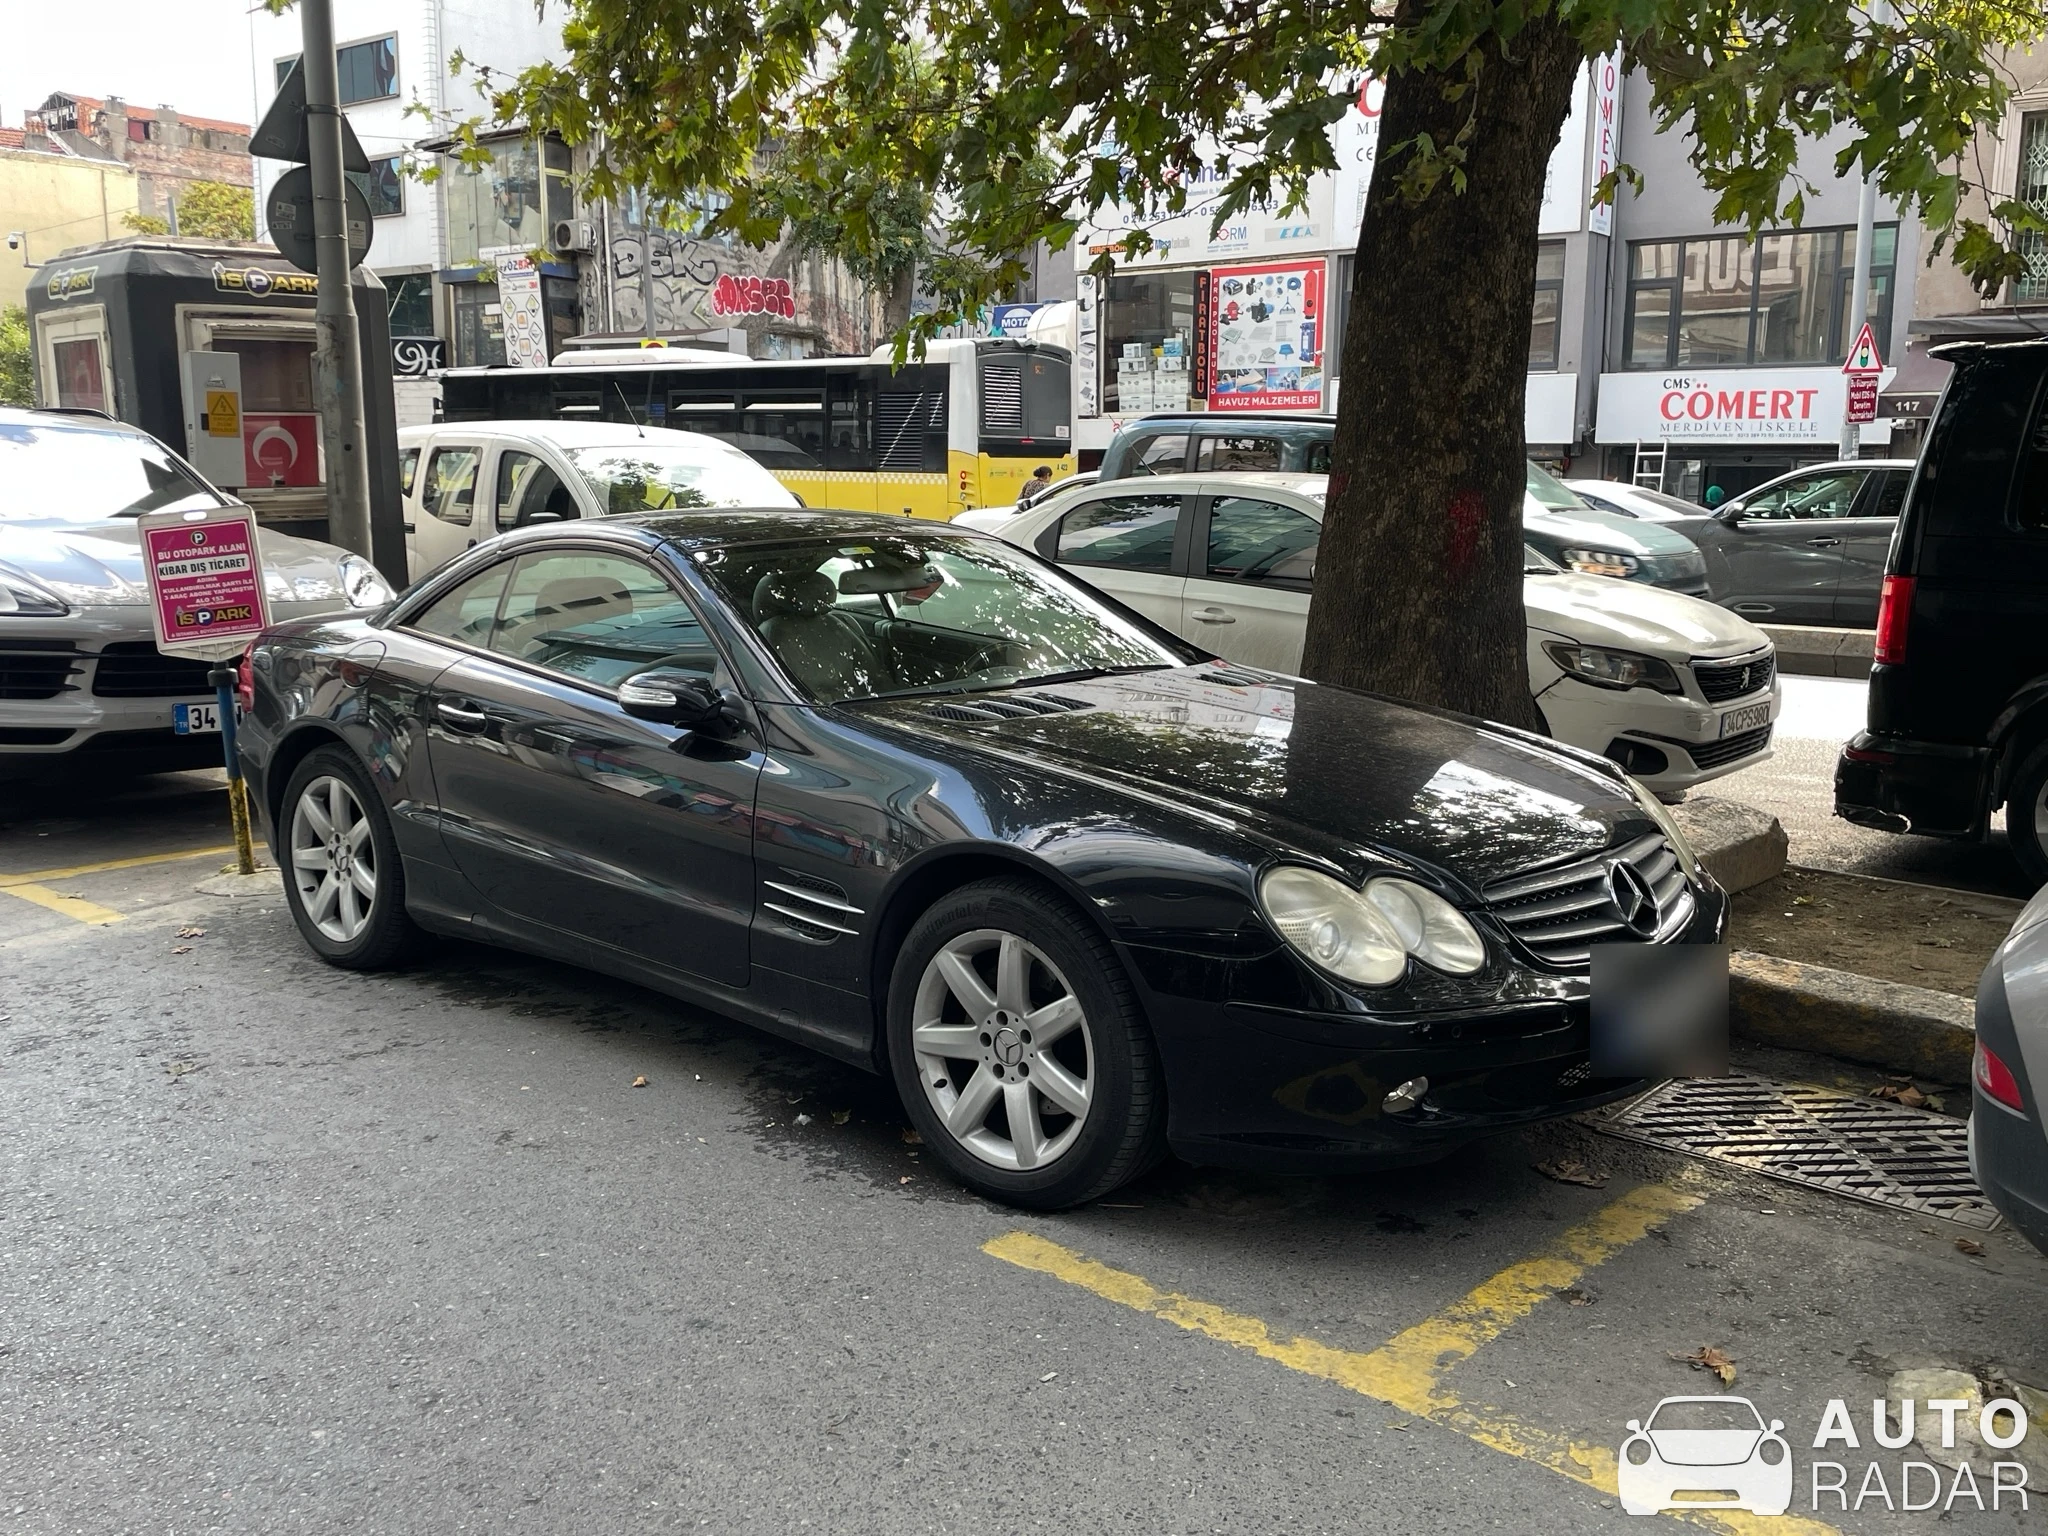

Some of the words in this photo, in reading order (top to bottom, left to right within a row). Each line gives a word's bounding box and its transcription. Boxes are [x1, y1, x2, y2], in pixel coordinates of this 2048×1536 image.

[1150, 211, 1166, 222] 253
[1196, 276, 1207, 394] FIRATBORU
[1663, 378, 1690, 390] CMS
[1218, 397, 1250, 408] HAVUZ
[1252, 394, 1318, 407] MALZEMELERİ
[1660, 382, 1819, 421] CÖMERT
[1896, 401, 1920, 412] 117
[1660, 421, 1744, 432] MERDİVEN
[1759, 420, 1818, 432] İSKELE
[158, 551, 171, 560] BU
[173, 546, 217, 559] OTOPARK
[218, 543, 246, 554] ALANI
[158, 564, 188, 577] KİBAR
[190, 562, 206, 574] DIŞ
[208, 558, 246, 571] TİCARET
[178, 606, 251, 626] İSPARK
[190, 708, 216, 730] 34
